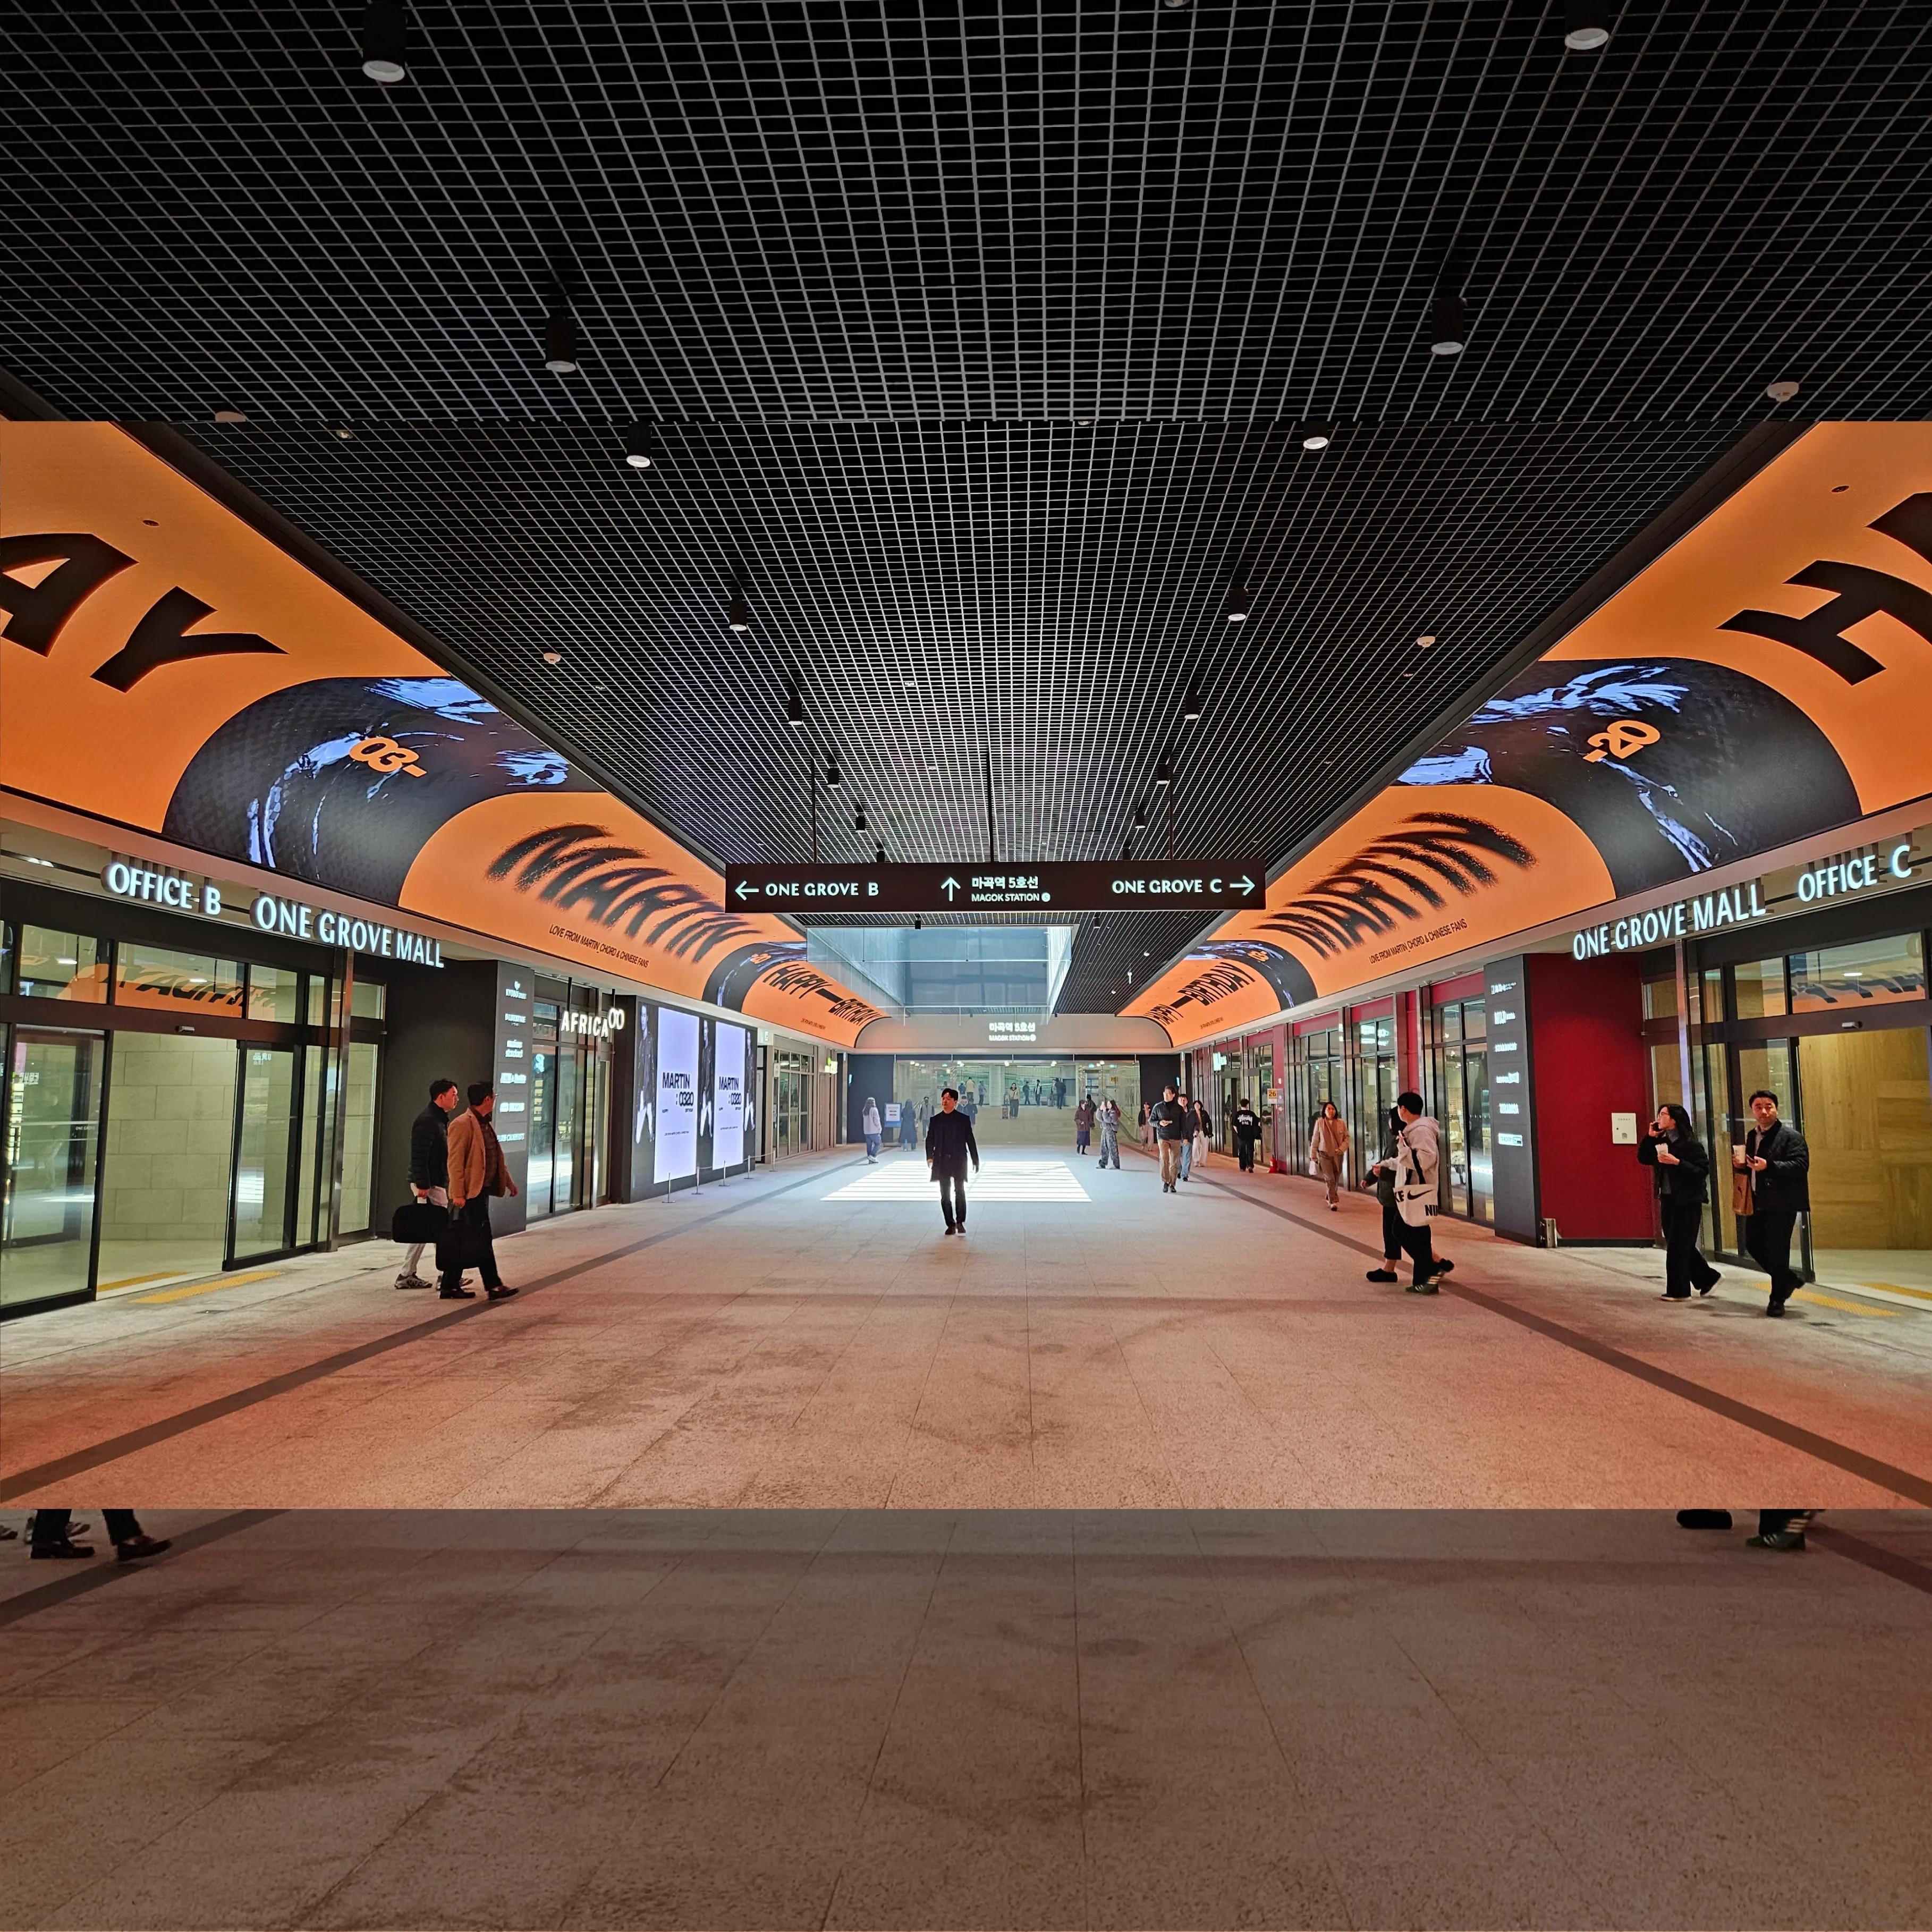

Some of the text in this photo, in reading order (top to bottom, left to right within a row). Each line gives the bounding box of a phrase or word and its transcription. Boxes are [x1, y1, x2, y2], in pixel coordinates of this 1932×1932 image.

[107, 863, 222, 916] OFFICE B
[765, 882, 879, 896] ONE GROVE B
[971, 876, 1038, 889] 마곡역 5호선
[1112, 878, 1222, 894] ONE GROVE C
[1798, 844, 1912, 903] OFFICE C
[971, 893, 1004, 902] MAGOK
[1004, 893, 1040, 902] STATION
[257, 896, 445, 969] ONE GROVE MALL
[1573, 884, 1766, 962] ONE GROVE MALL
[549, 924, 564, 938] LOVE
[563, 930, 580, 943] FROM
[620, 951, 639, 965] CHINESE
[637, 956, 649, 968] FANS
[1369, 953, 1380, 964] LOVE
[1379, 948, 1392, 960] FROM
[1428, 925, 1452, 942] CHINESE
[1450, 918, 1468, 933] FANS
[762, 964, 833, 999] HAPPY
[1176, 962, 1256, 1006] BIRTHDAY
[561, 1010, 608, 1038] AFRICA
[662, 1072, 690, 1089] MARTIN
[718, 1076, 739, 1091] MARTIN
